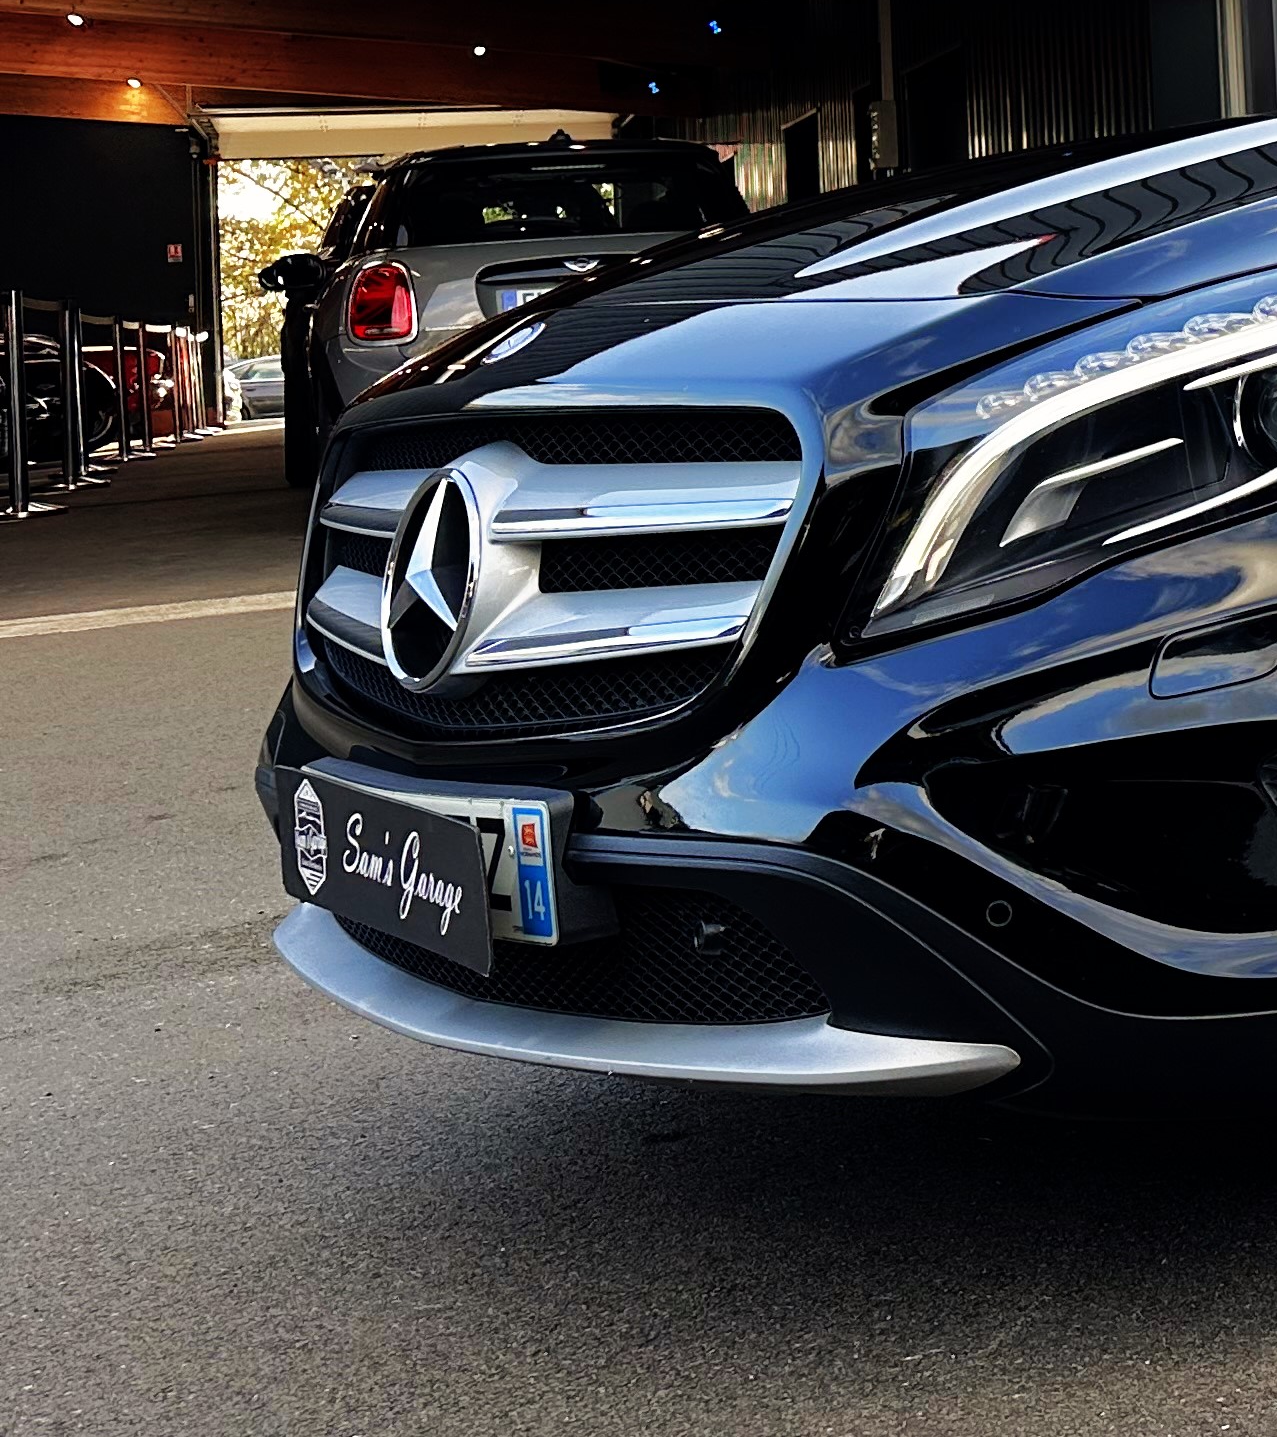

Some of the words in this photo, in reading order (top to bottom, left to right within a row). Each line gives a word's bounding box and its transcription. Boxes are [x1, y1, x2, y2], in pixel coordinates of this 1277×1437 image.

[342, 812, 393, 887] Sam's
[399, 830, 463, 936] Garage
[523, 879, 546, 921] 14
